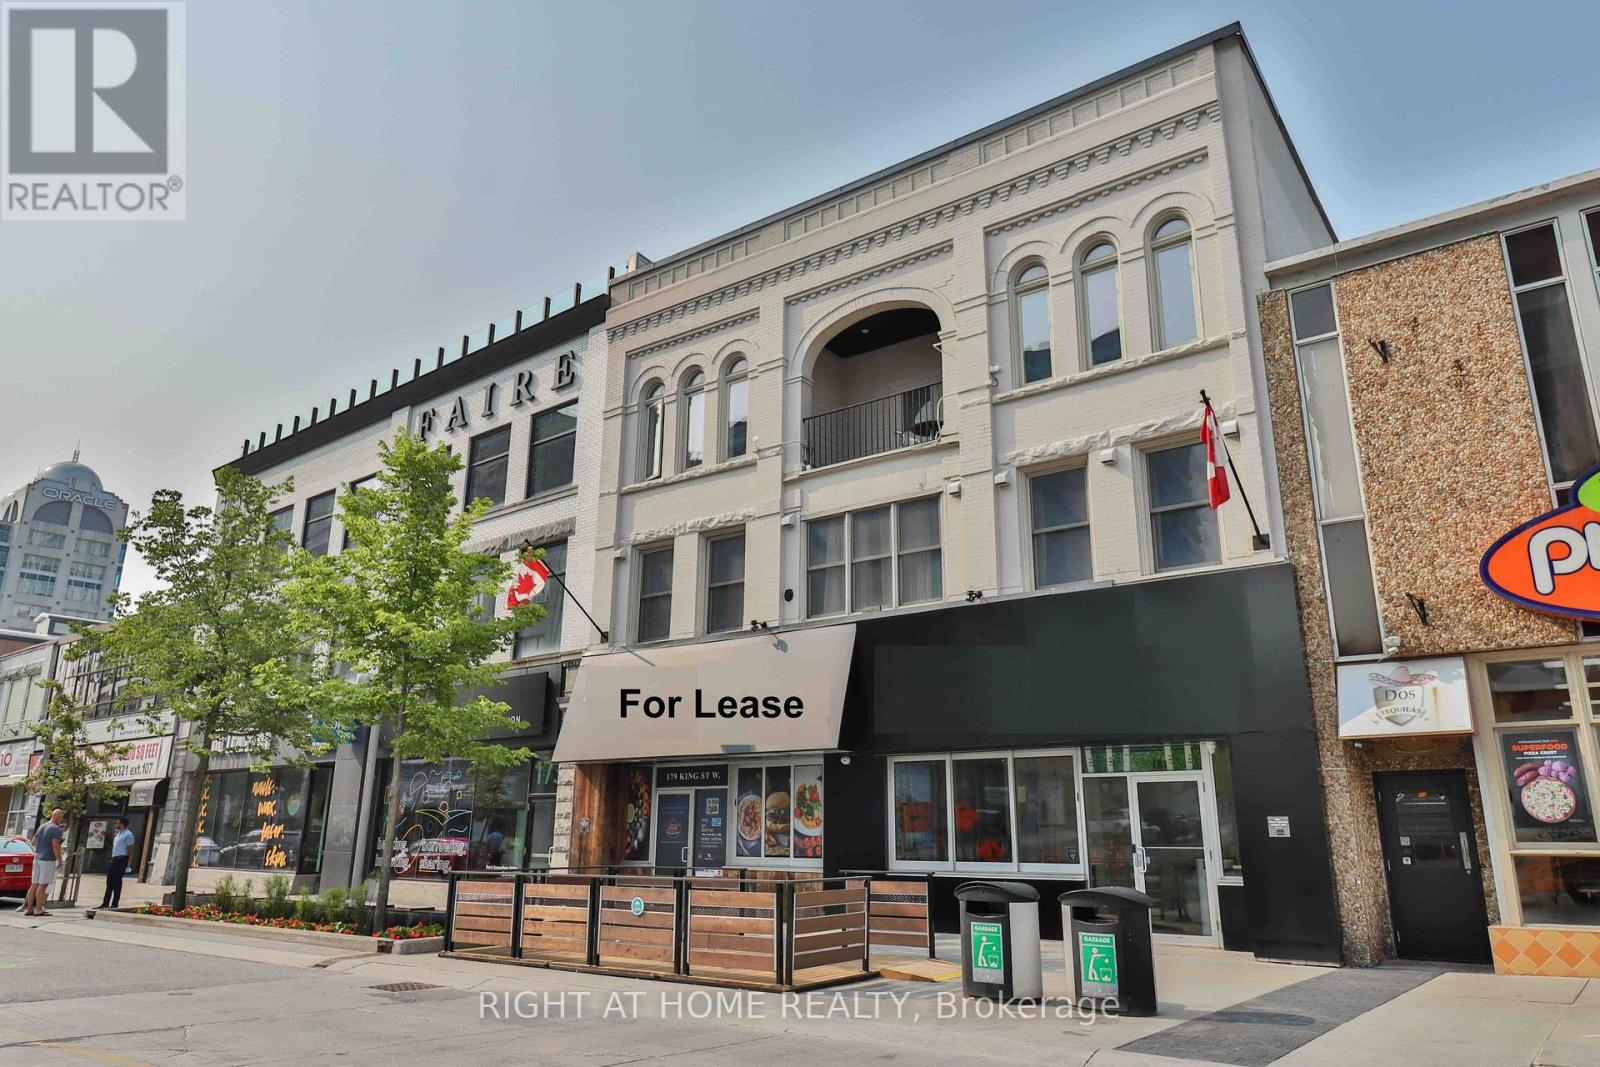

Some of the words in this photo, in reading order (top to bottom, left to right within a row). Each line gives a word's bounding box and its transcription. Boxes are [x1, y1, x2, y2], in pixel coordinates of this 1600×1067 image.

[418, 350, 576, 442] FAIRE
[43, 488, 117, 510] ORACLE
[620, 689, 682, 718] For
[695, 689, 804, 718] Lease
[1381, 706, 1421, 716] TEQUILAS
[145, 743, 159, 759] FEET
[1511, 743, 1568, 752] SUPERFOOD
[679, 772, 699, 781] KING
[700, 771, 711, 780] ST
[1083, 936, 1111, 944] GARBAGE
